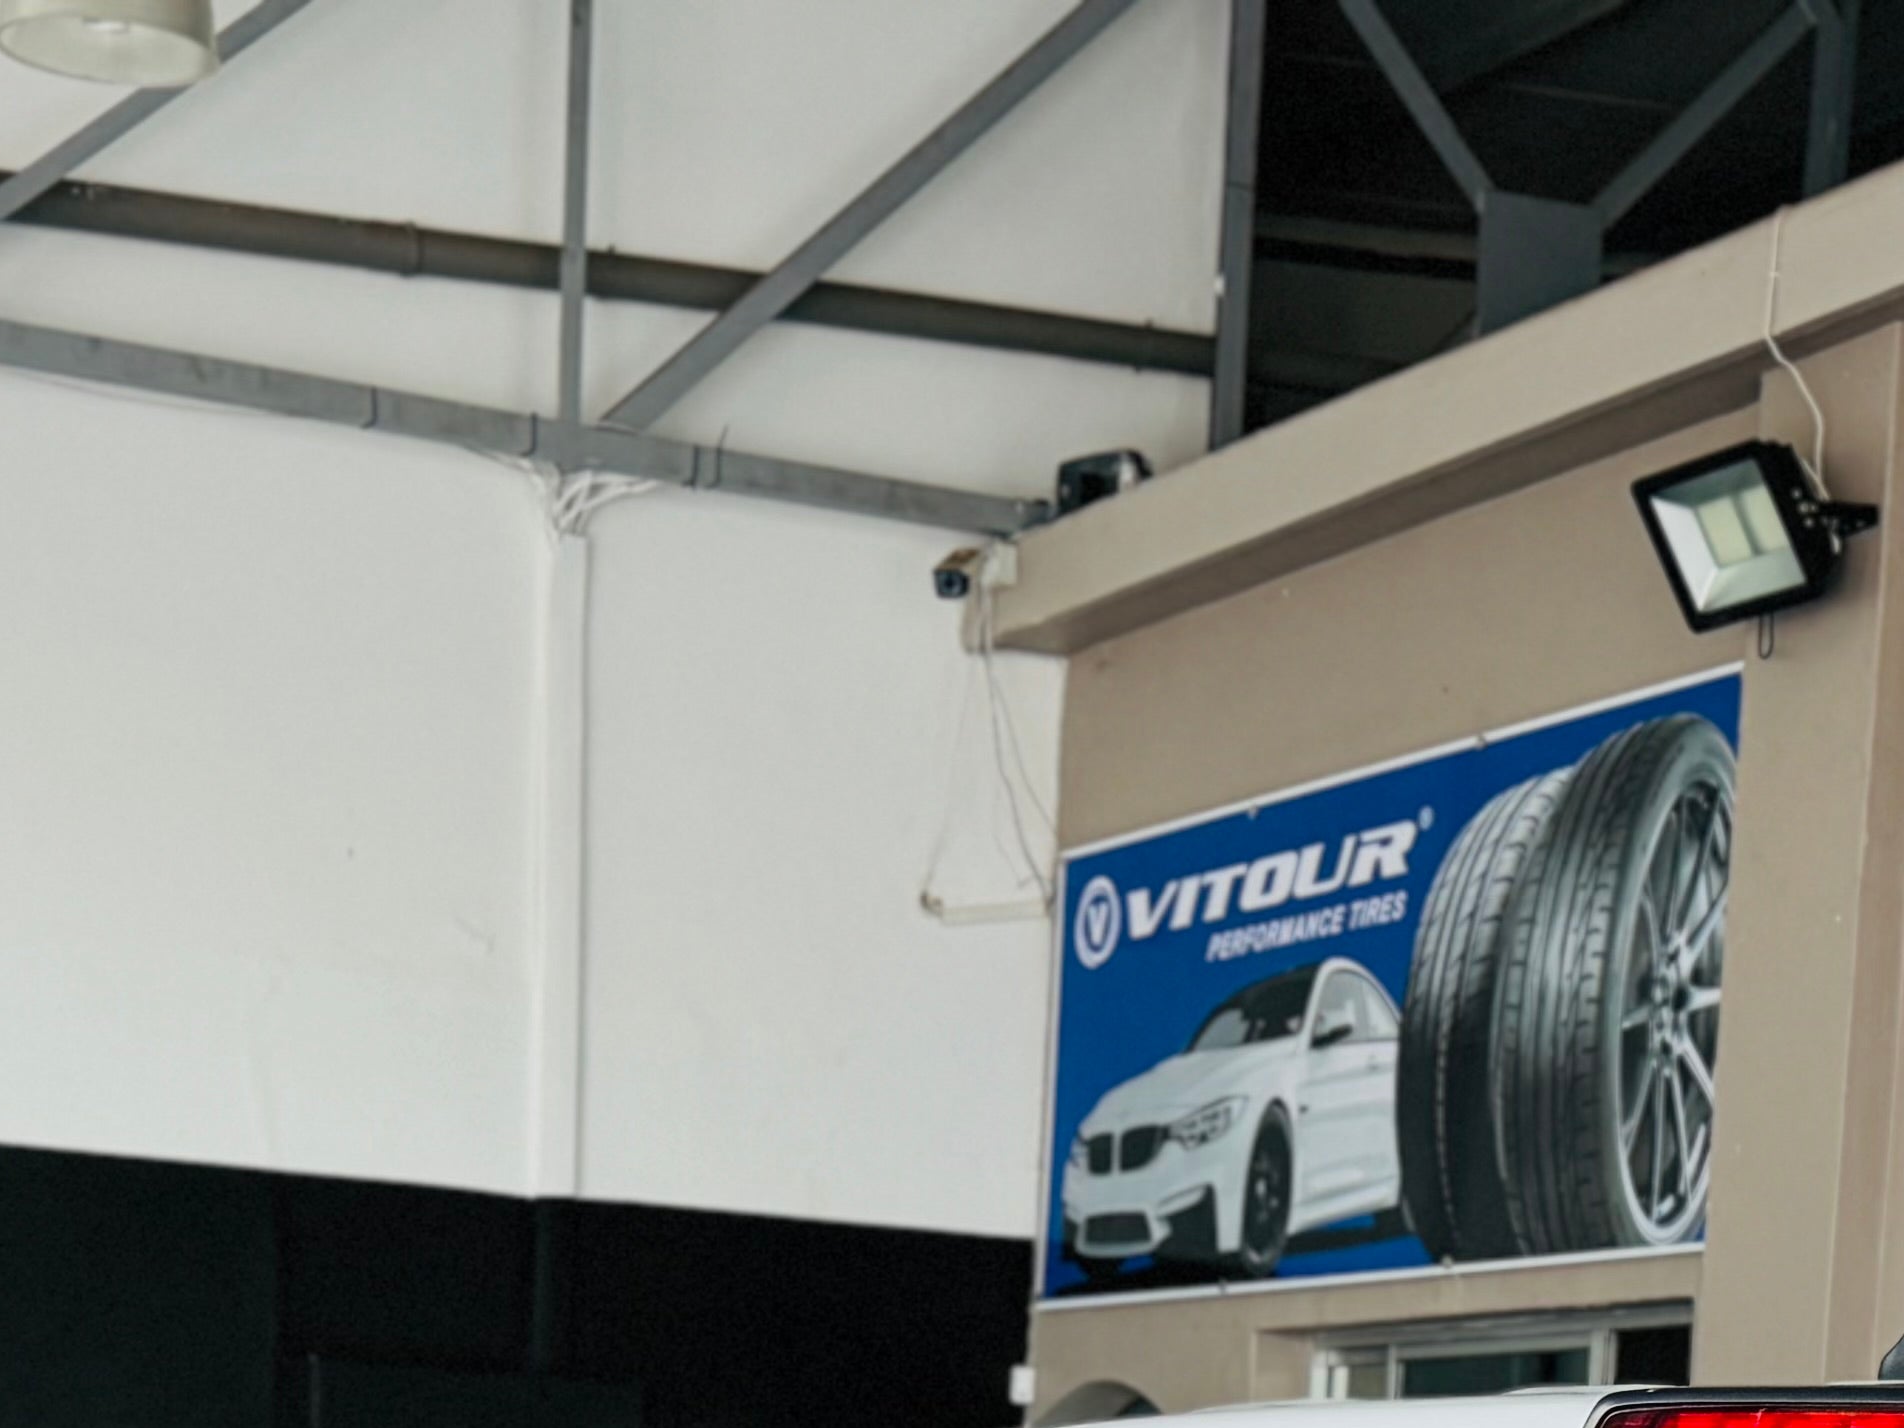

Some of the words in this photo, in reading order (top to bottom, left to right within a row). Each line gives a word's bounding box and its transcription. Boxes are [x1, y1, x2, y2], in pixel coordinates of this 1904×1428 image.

[1125, 819, 1418, 941] VITOUR
[1204, 909, 1344, 963] PERFORMANCE
[1347, 890, 1408, 931] TIRES
